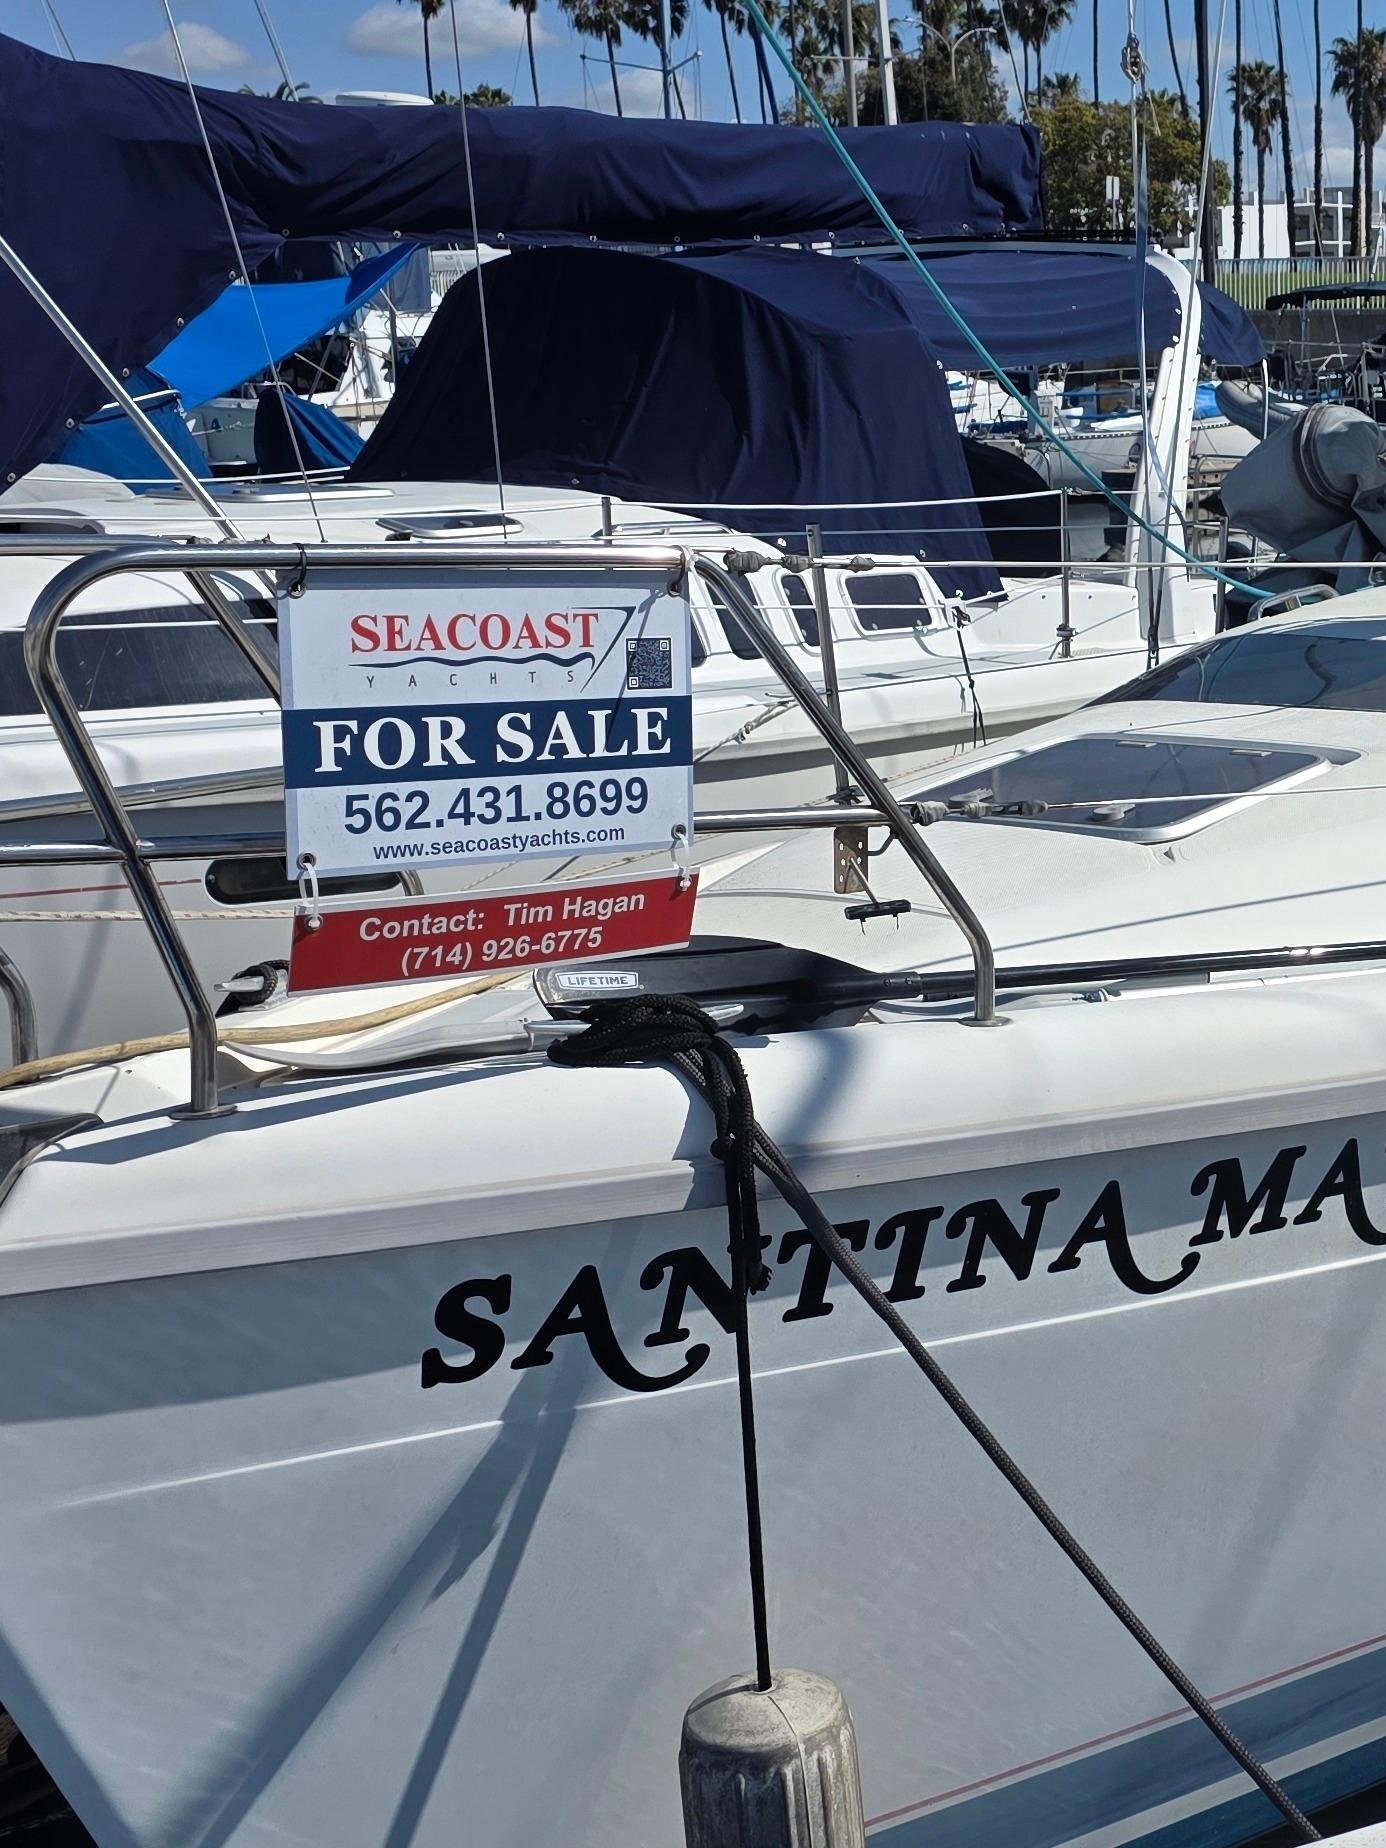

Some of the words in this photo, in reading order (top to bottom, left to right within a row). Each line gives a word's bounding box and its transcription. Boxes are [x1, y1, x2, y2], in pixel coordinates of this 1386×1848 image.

[350, 612, 600, 654] SEACOAST
[365, 670, 575, 690] YACHTS
[312, 716, 476, 773] FOR
[496, 707, 671, 763] SALE
[344, 776, 649, 835] 562.431.8699
[373, 825, 626, 860] www.seacoastyachts.com
[359, 912, 485, 942] Contact:
[503, 902, 553, 927] Tim
[562, 890, 646, 922] Hagan
[401, 942, 473, 977] (714)
[481, 926, 603, 963] 926-6775
[567, 976, 629, 986] LIFETIME
[421, 1180, 1200, 1393] SANTINA
